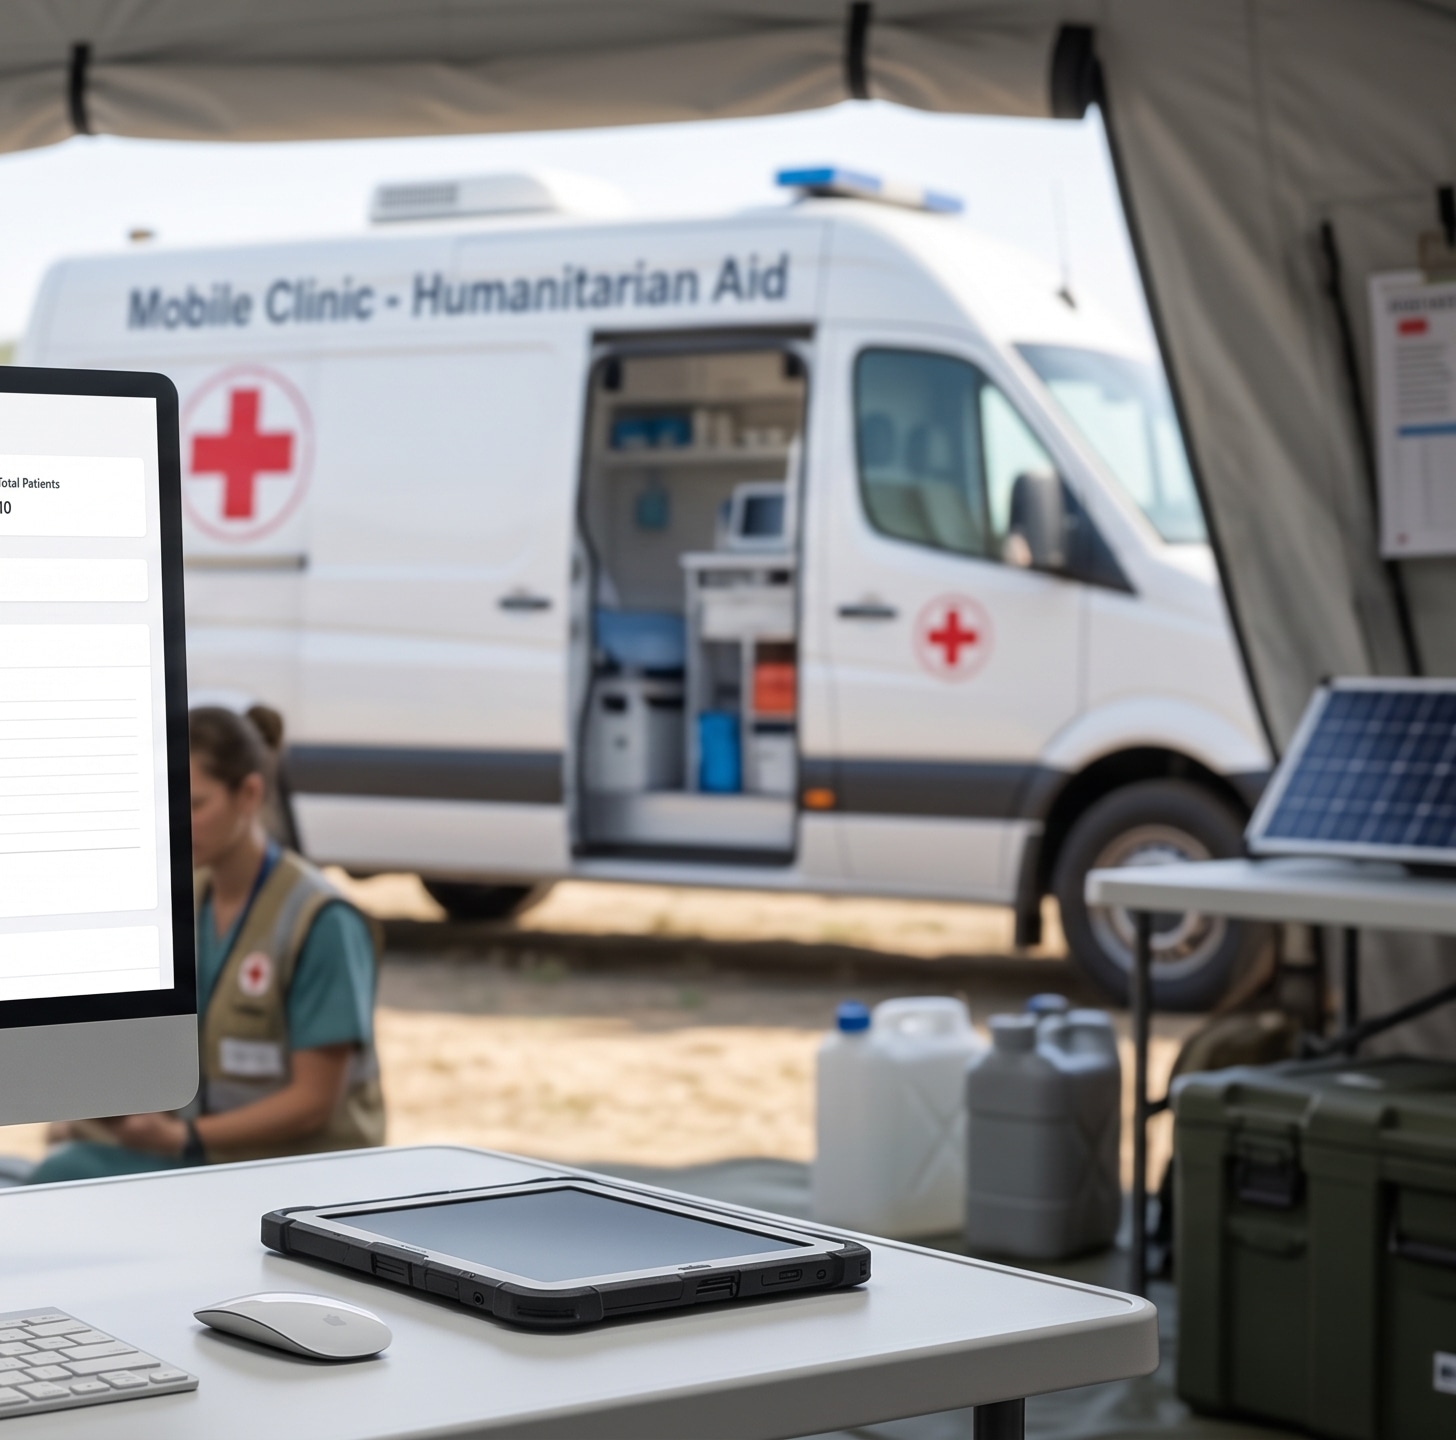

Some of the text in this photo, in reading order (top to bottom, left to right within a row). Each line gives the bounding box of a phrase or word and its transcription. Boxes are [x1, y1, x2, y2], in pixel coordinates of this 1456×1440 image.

[127, 283, 253, 331] Mobile
[265, 276, 373, 324] Clinic
[411, 261, 698, 318] Humanitarian
[713, 253, 790, 302] Aid
[23, 478, 60, 489] Patients
